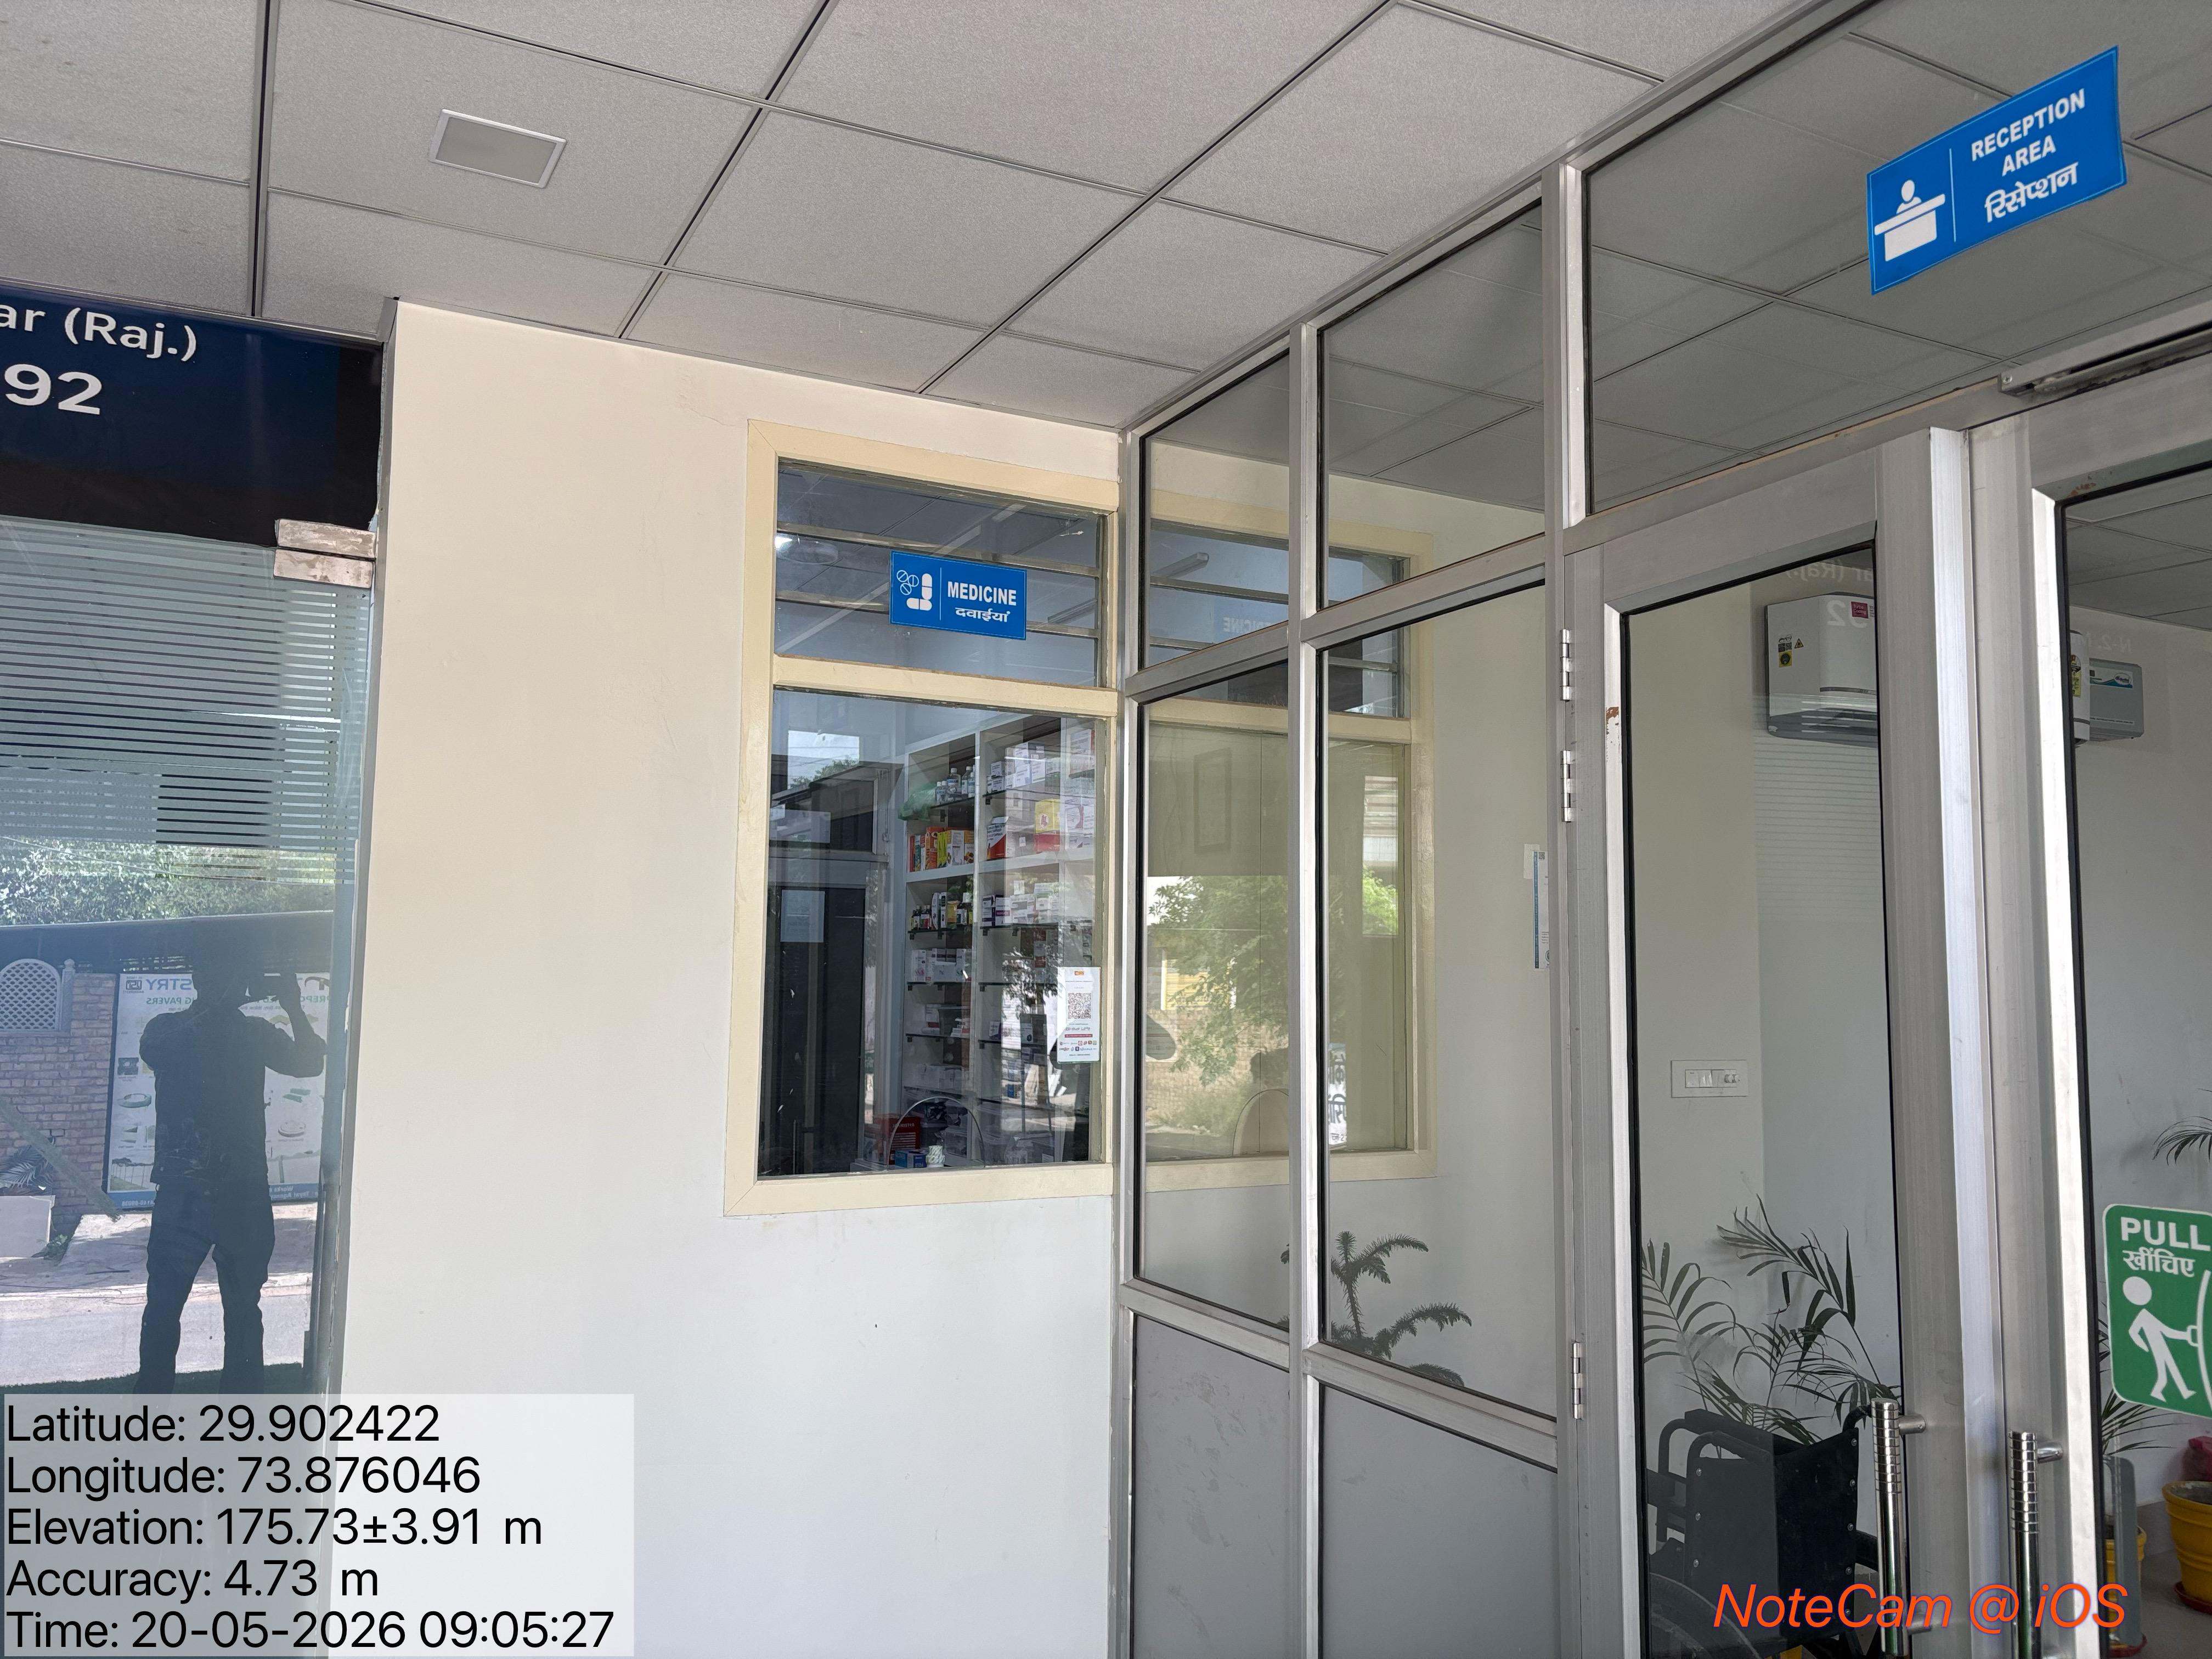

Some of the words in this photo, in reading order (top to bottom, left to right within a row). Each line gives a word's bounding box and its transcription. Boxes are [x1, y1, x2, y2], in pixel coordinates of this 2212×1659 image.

[1971, 88, 2085, 161] RECEPTION
[2002, 135, 2056, 177] AREA
[1984, 161, 2078, 223] रिसेप्शन
[0, 305, 46, 331] ar
[65, 307, 197, 362] (Raj.)
[4, 364, 102, 415] 92
[947, 581, 1016, 606] MEDICINE
[955, 607, 1011, 622] दवाईयां
[2120, 1216, 2211, 1251] PULL
[2122, 1247, 2196, 1278] खींचिए
